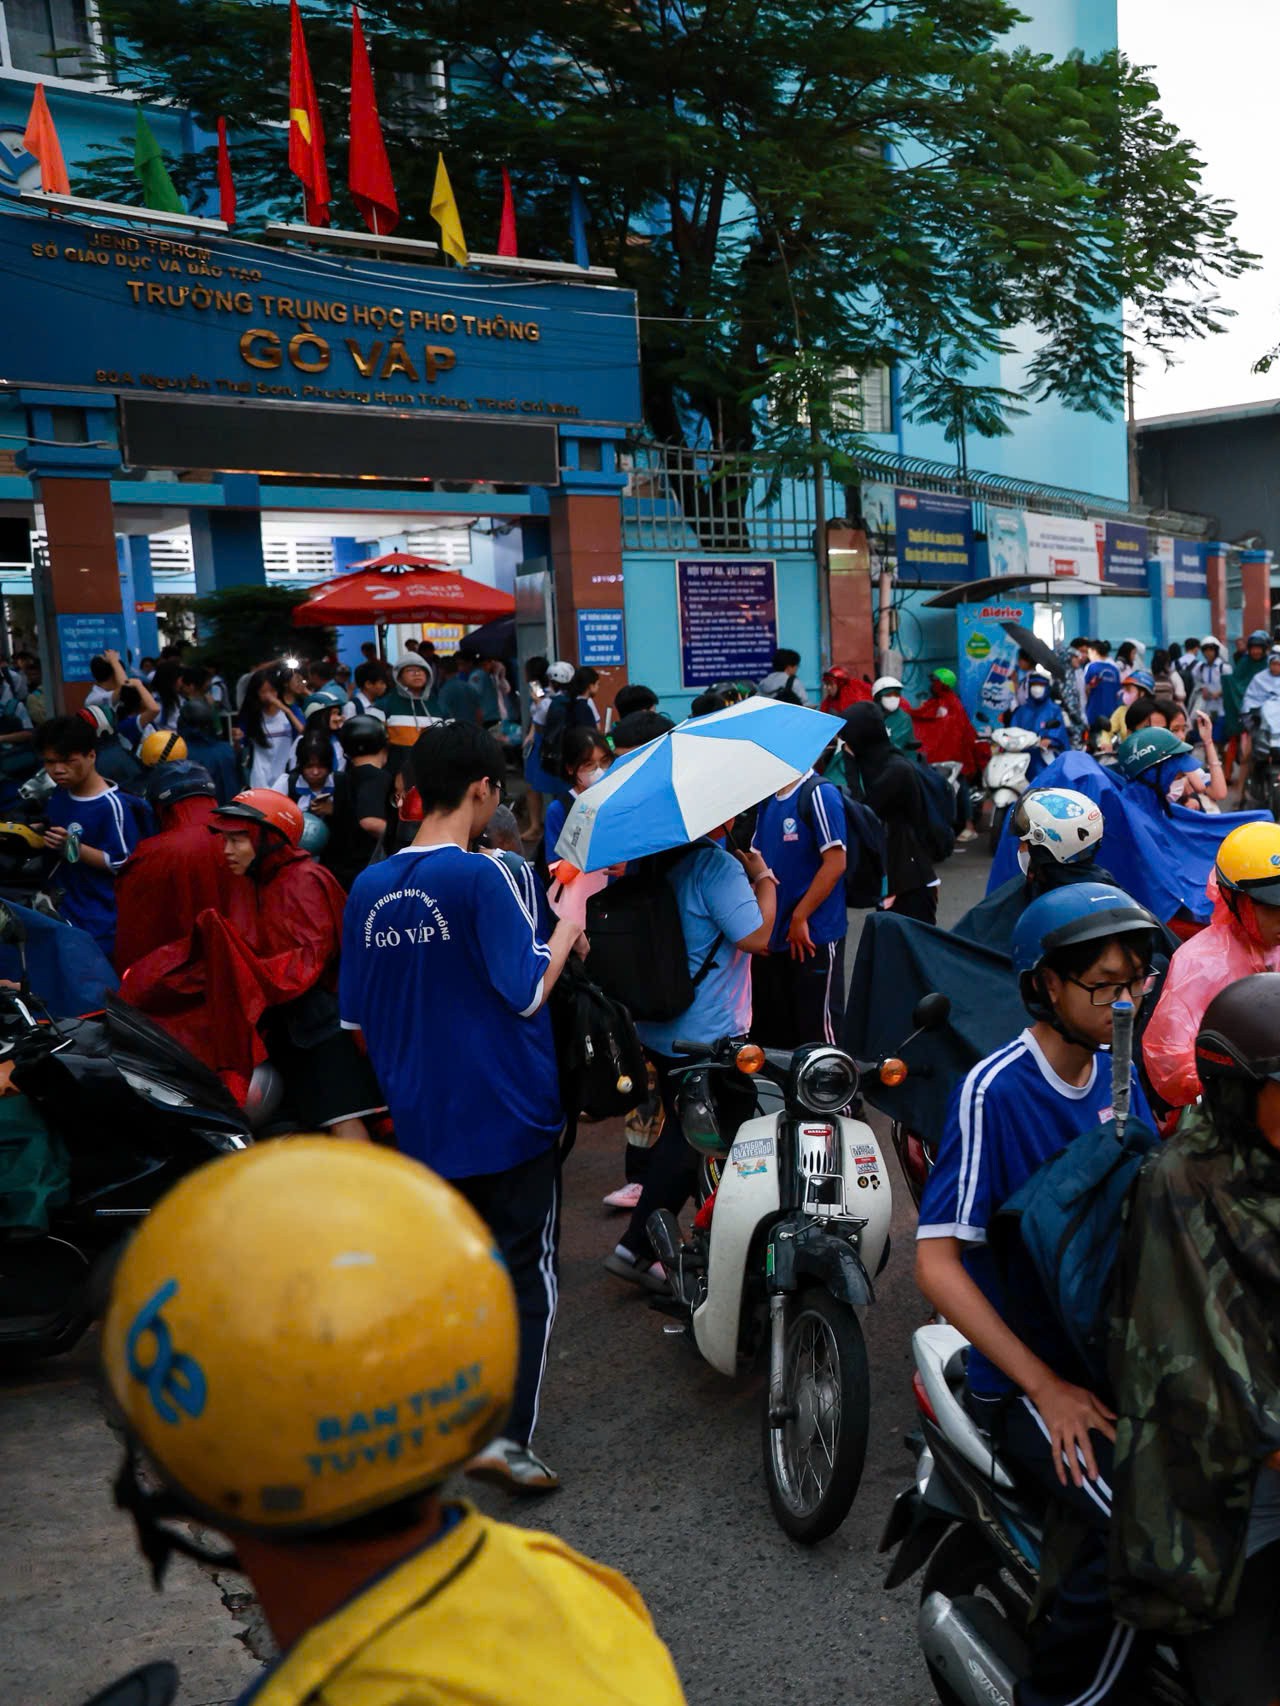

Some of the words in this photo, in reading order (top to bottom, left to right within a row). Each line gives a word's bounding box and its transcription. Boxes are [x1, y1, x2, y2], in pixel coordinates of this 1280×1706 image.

[126, 280, 254, 314] TRƯỜNG
[258, 295, 348, 323] TRUNG
[352, 305, 404, 331] HỌC
[461, 314, 541, 341] THÔNG
[239, 322, 331, 373] GÒ
[345, 328, 457, 383] VẤP
[979, 606, 1023, 618] Bidrico
[374, 890, 402, 910] TRUNG
[432, 907, 450, 940] THÔNG
[375, 926, 400, 948] GÒ
